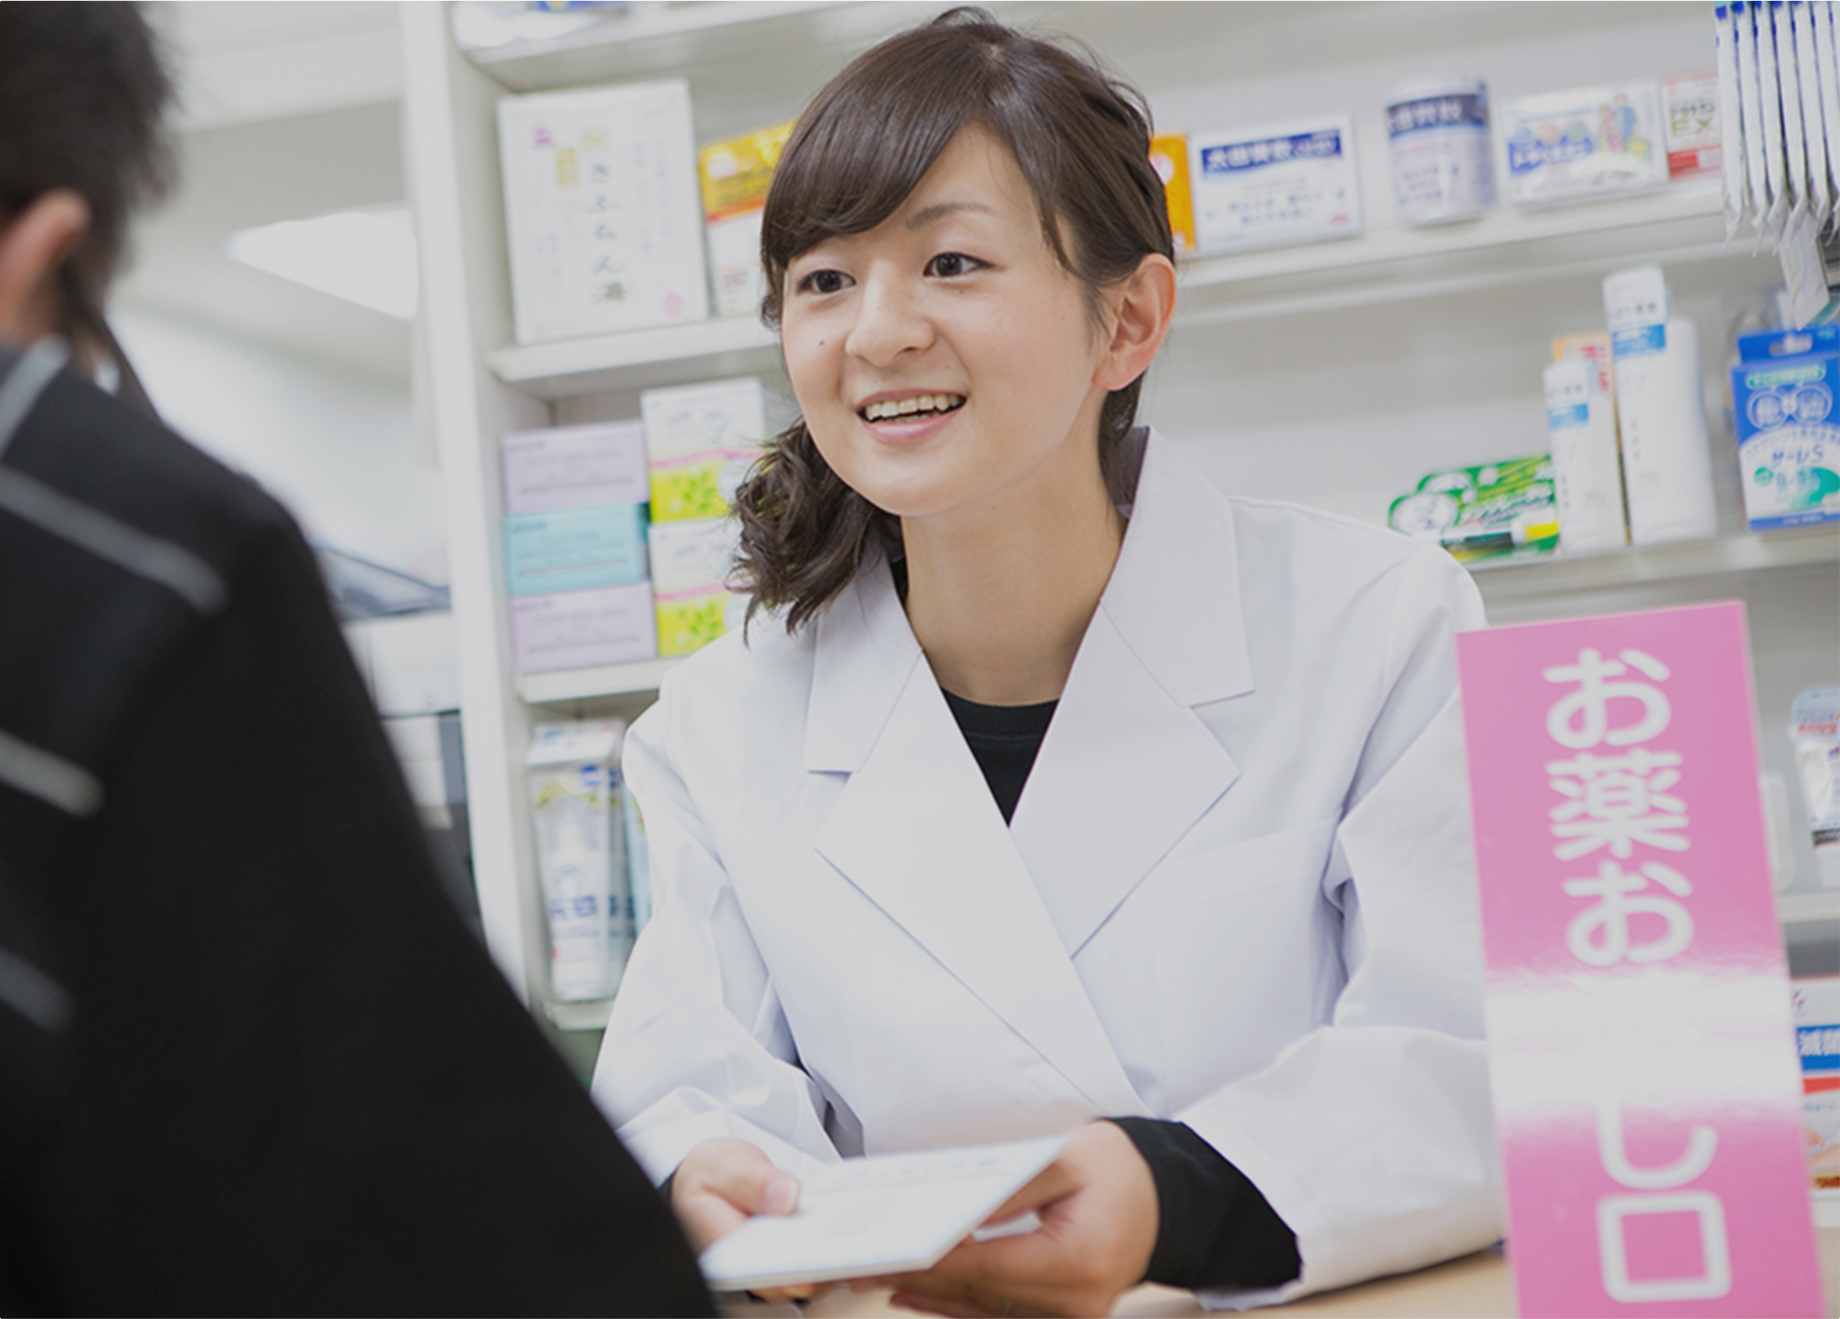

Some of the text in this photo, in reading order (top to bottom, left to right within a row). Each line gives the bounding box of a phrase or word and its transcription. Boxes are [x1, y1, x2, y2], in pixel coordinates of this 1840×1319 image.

[1671, 115, 1717, 138] EX
[1543, 648, 1732, 1303] お薬おし口
